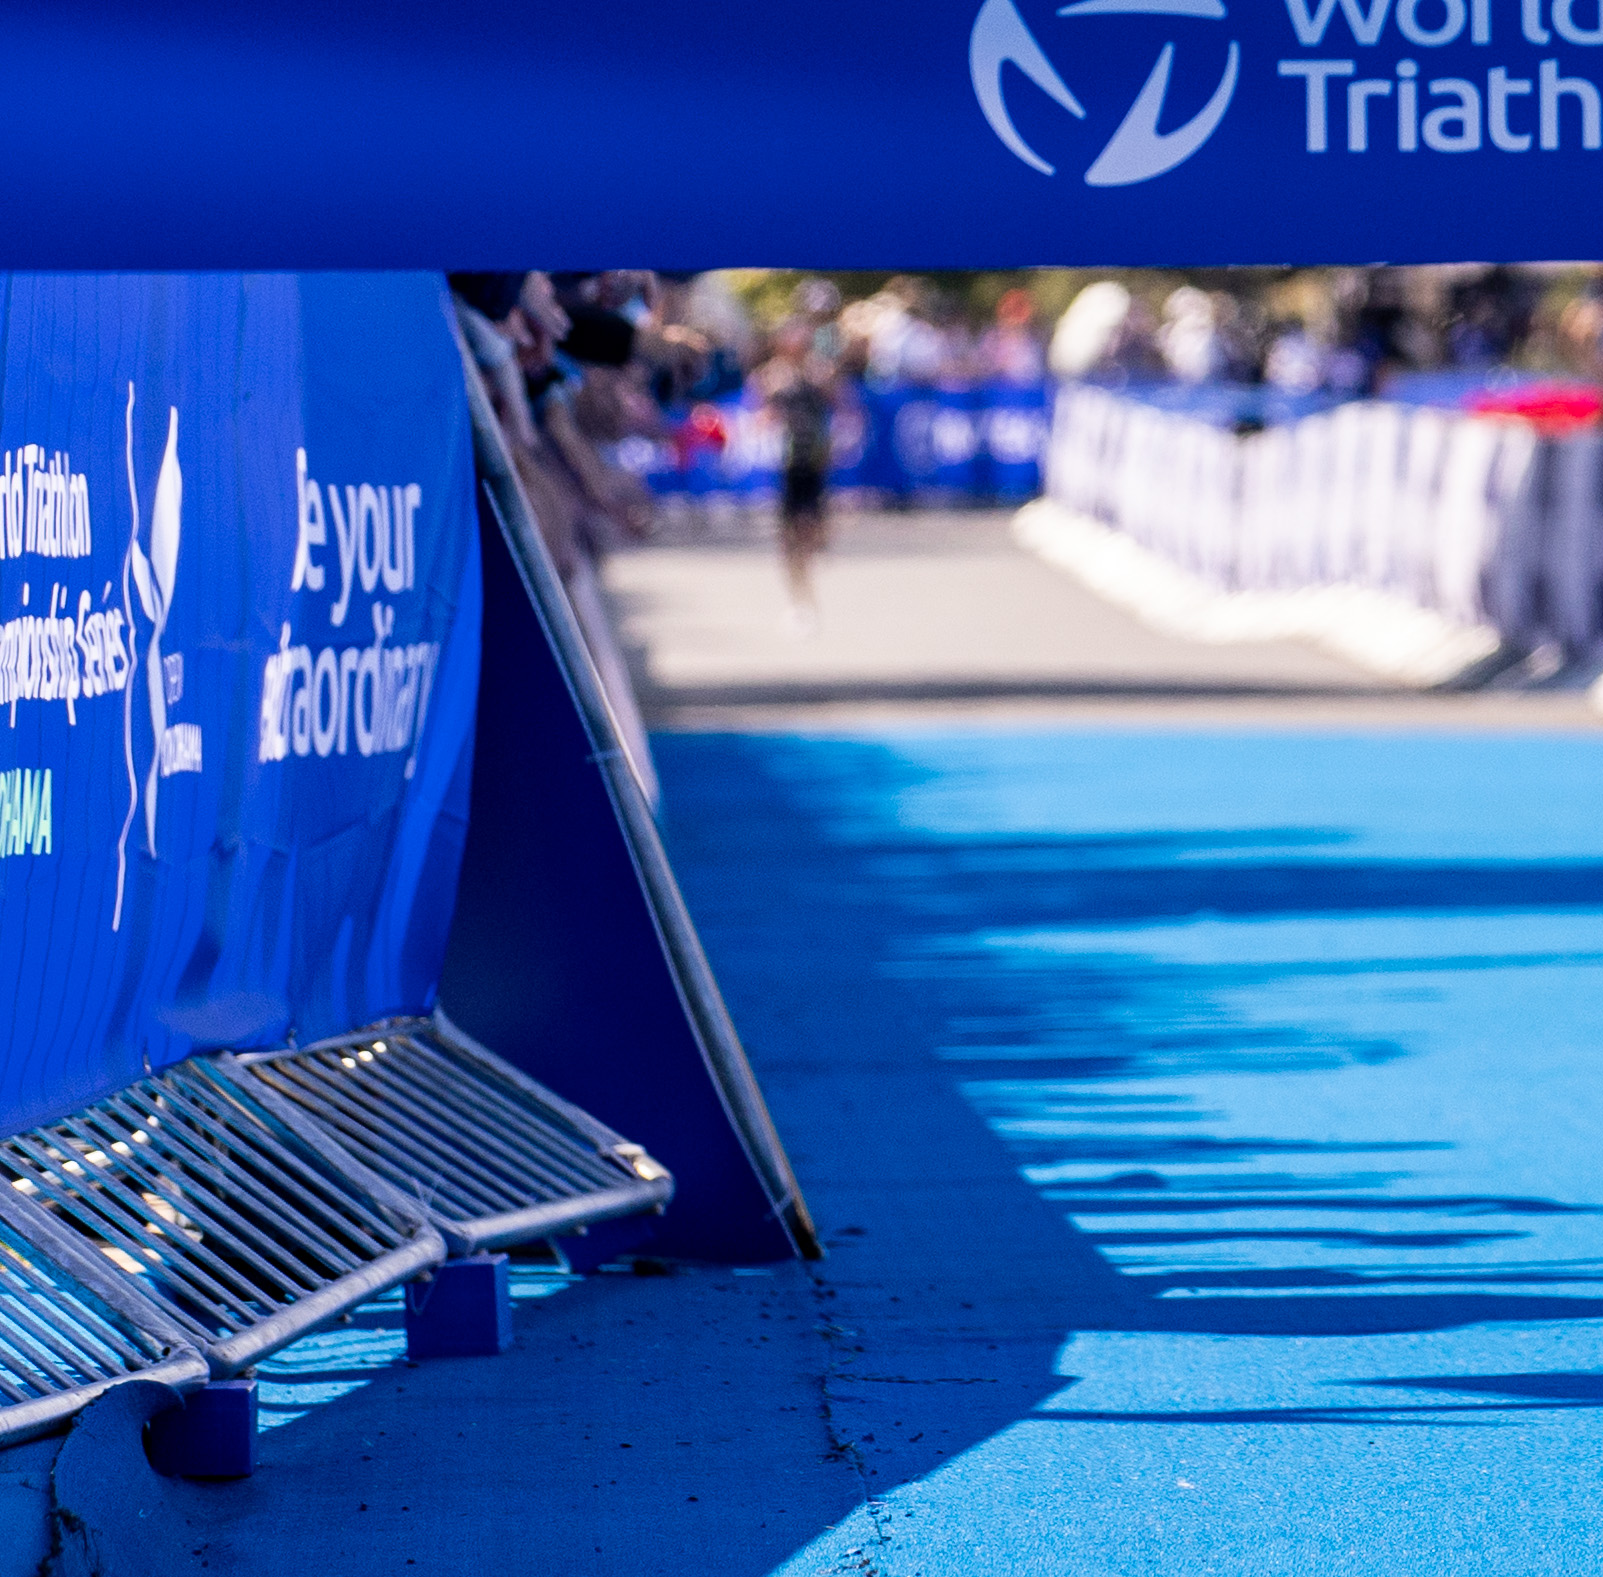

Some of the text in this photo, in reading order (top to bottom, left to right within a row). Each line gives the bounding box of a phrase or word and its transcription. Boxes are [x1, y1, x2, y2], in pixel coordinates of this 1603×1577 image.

[24, 443, 92, 559] Triathlon
[327, 482, 423, 627] your
[76, 580, 130, 699] Series
